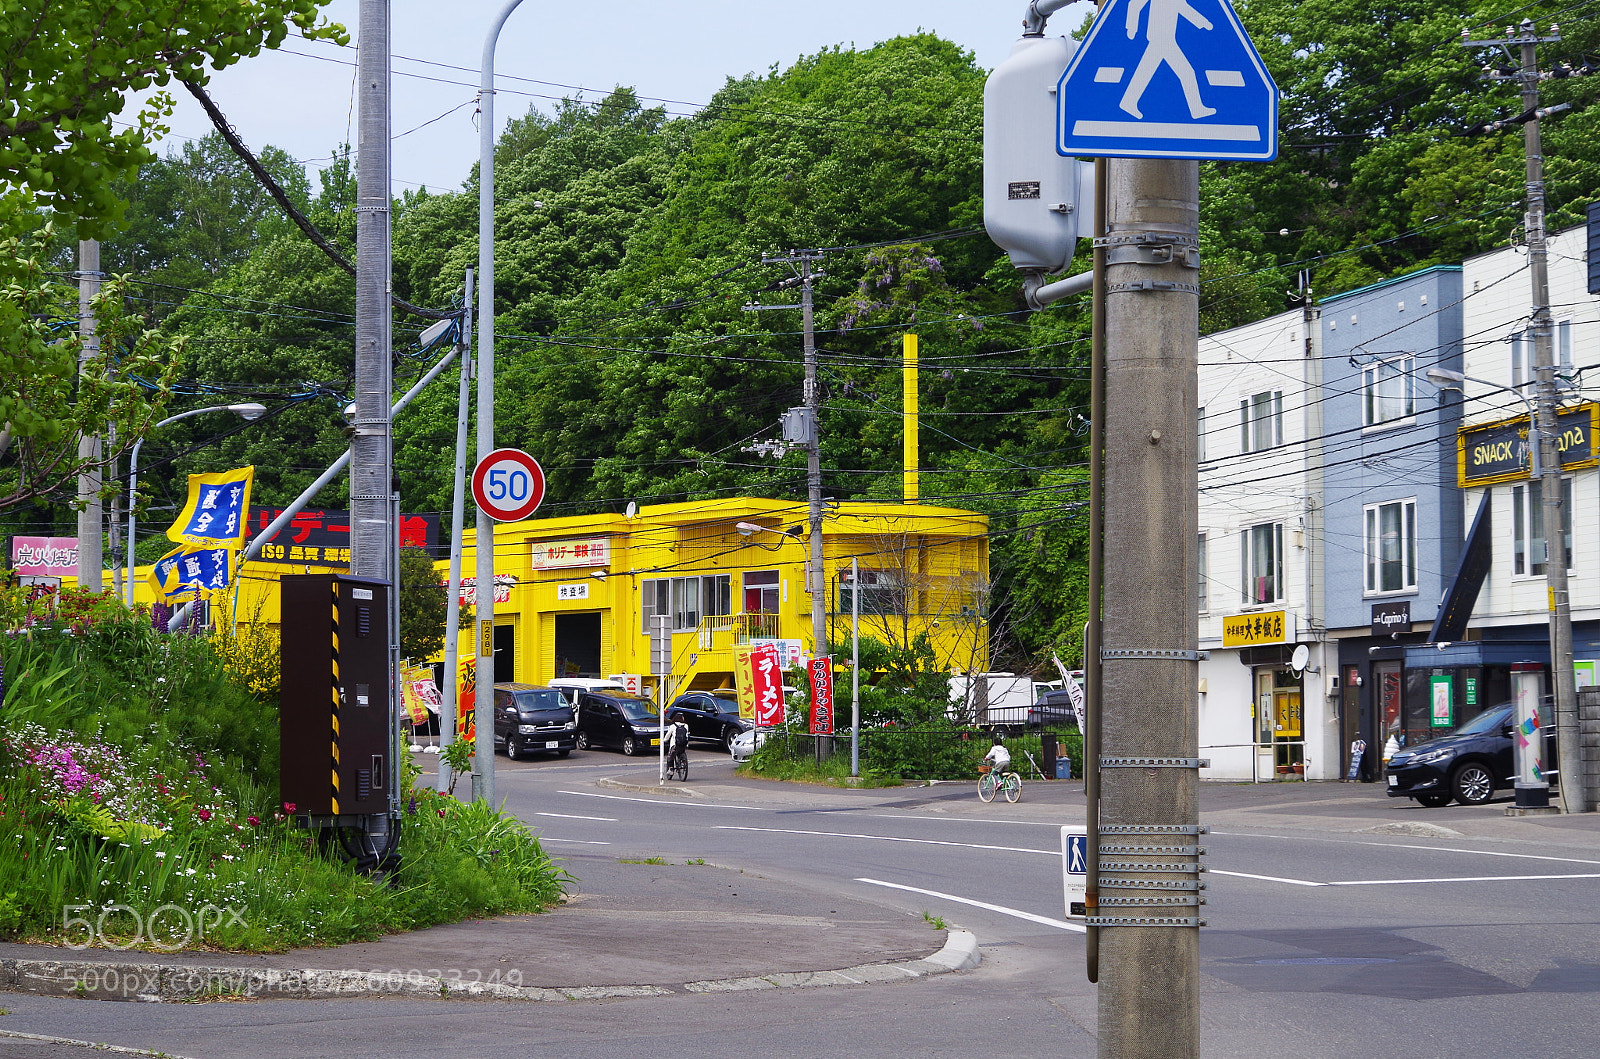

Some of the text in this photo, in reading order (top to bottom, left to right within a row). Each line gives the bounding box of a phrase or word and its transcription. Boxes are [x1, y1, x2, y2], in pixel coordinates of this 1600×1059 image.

[1474, 426, 1585, 466] SNACK ana
[489, 469, 528, 502] 50
[261, 545, 285, 559] ISO
[560, 585, 587, 598] 検査場
[1245, 615, 1282, 640] 大華飯店
[738, 652, 754, 713] ラーメン
[758, 657, 779, 720] ラーメン
